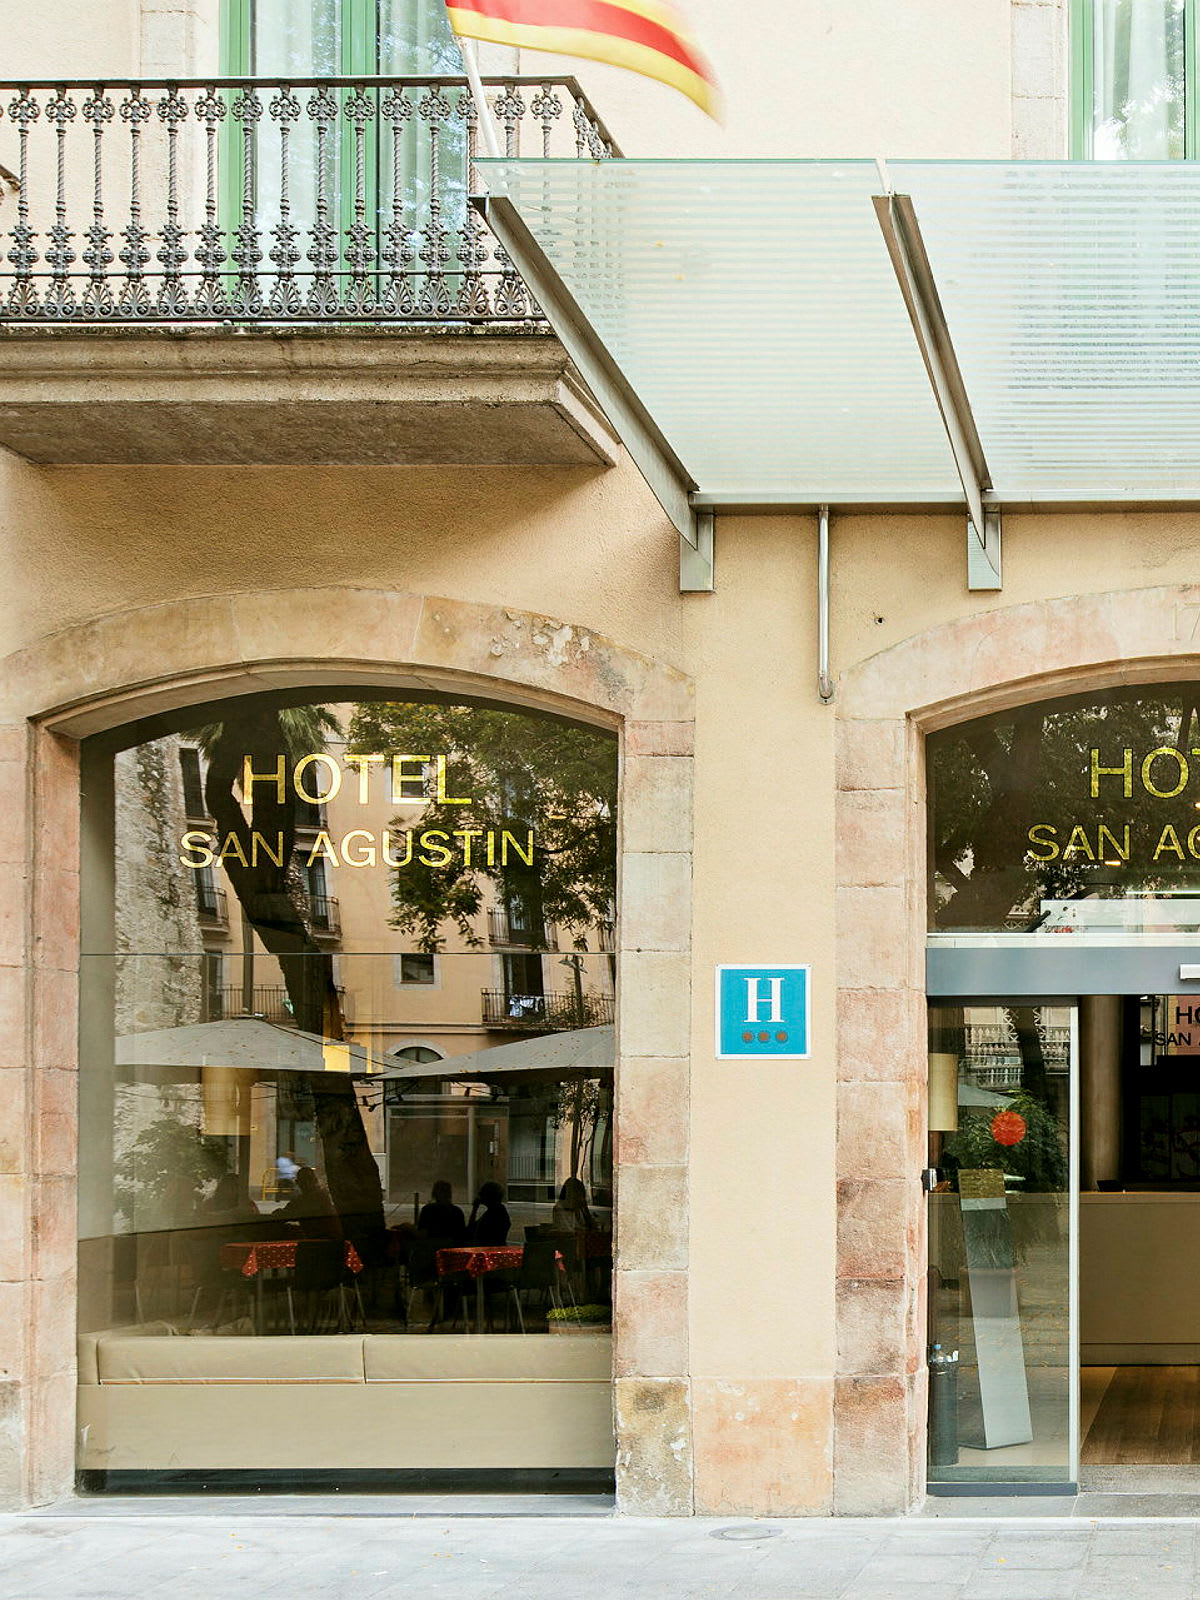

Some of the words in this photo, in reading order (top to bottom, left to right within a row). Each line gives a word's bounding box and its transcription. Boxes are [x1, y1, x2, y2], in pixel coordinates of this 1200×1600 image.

[242, 753, 472, 805] HOTEL
[179, 830, 285, 869] SAN
[306, 830, 535, 869] AGUSTIN
[1028, 823, 1130, 862] SAN
[743, 977, 785, 1023] H
[1155, 1032, 1191, 1046] SAN
